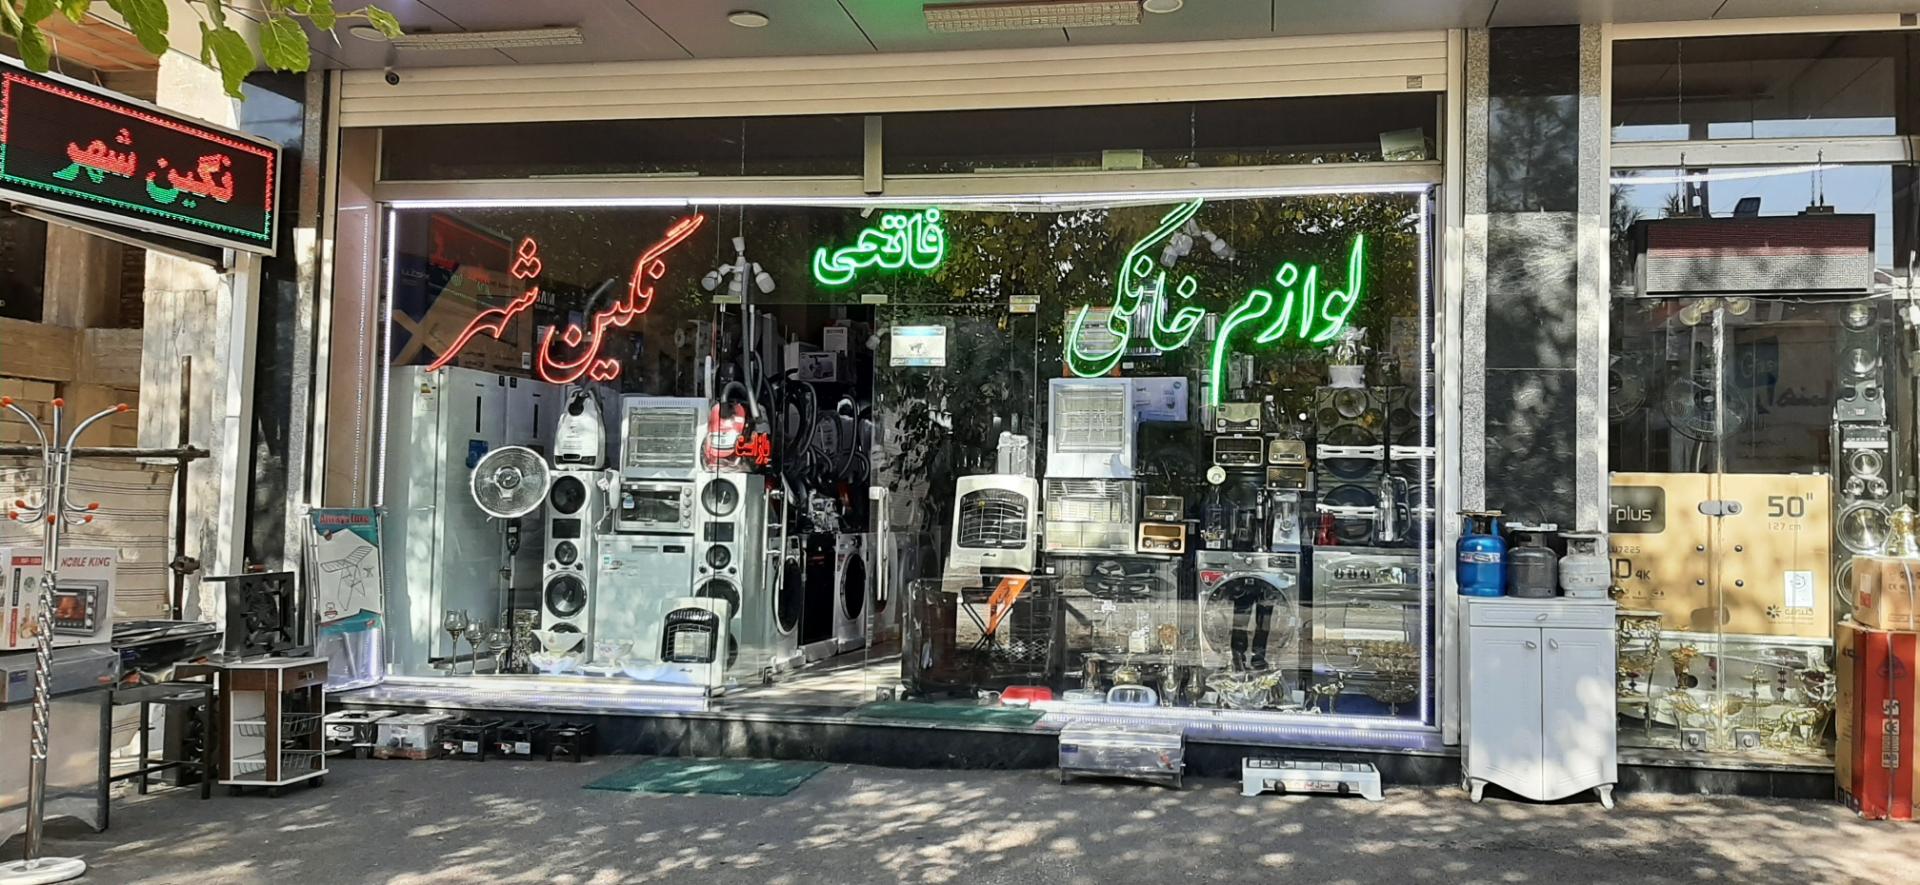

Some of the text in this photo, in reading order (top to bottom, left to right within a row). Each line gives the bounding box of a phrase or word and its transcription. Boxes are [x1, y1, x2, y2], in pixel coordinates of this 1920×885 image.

[52, 127, 235, 209] نگین شهر
[424, 214, 704, 384] نگین شهر
[1067, 197, 1364, 407] لوازم خانگی
[61, 556, 112, 568] NOBLE KING
